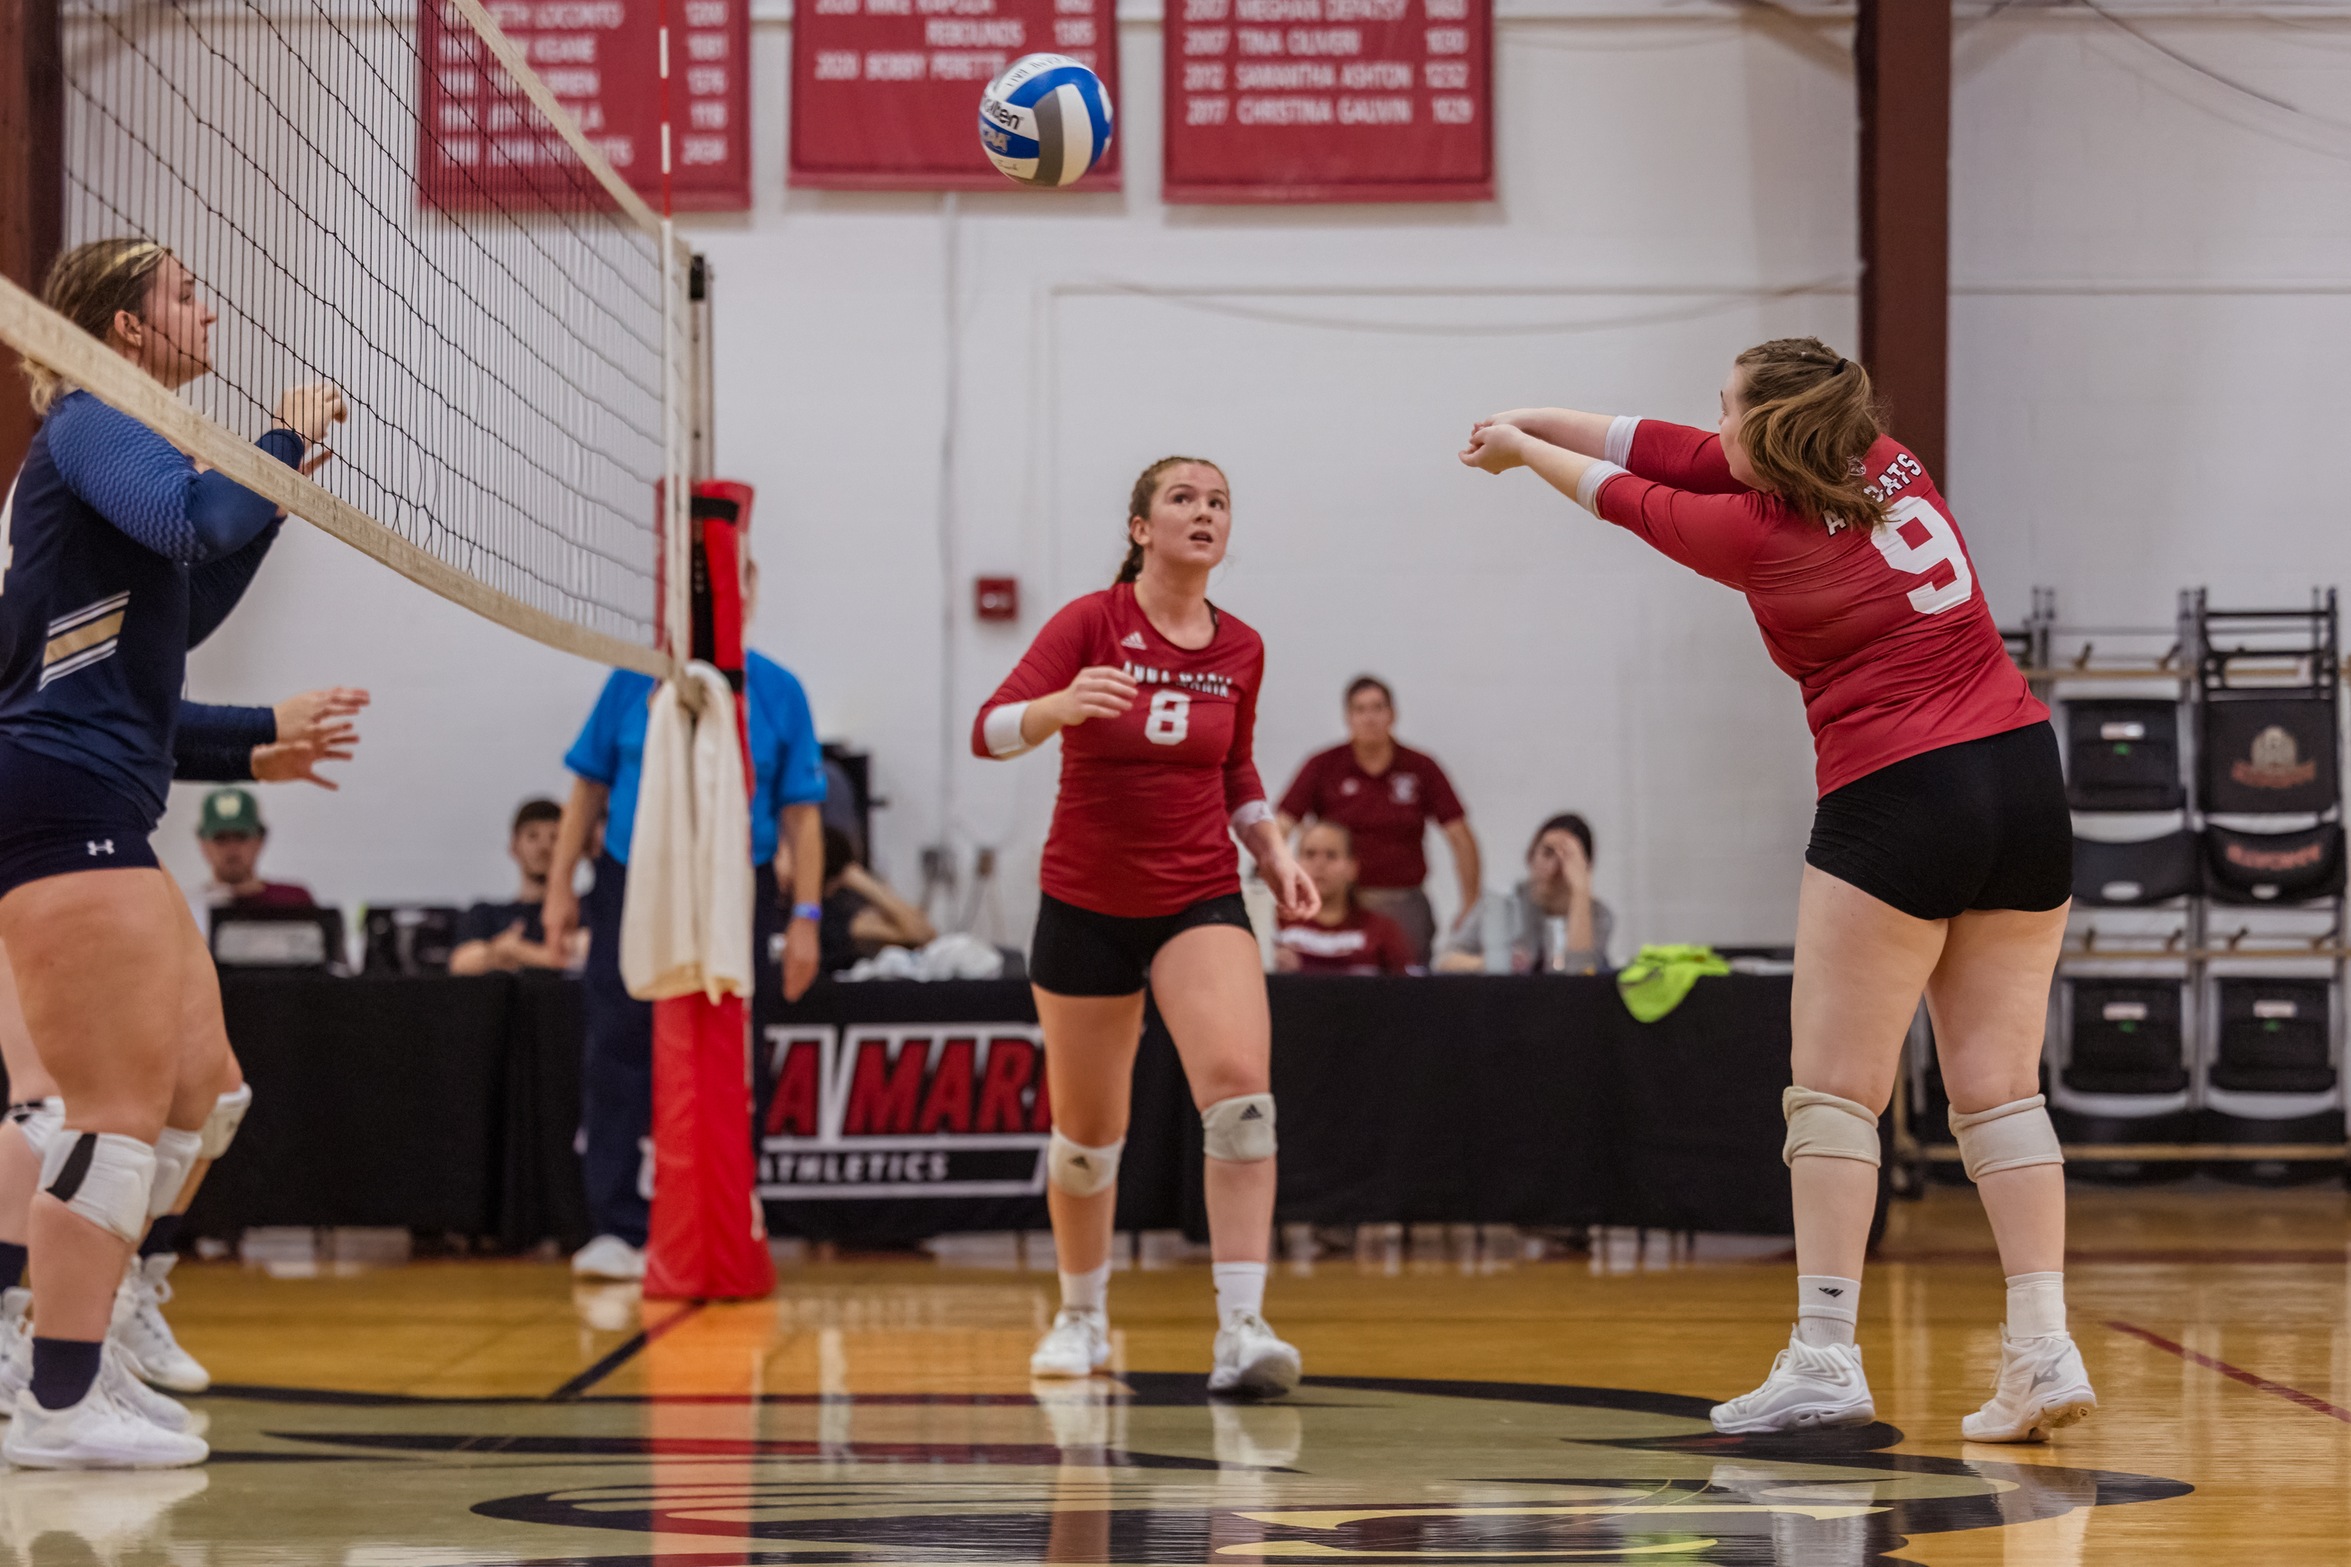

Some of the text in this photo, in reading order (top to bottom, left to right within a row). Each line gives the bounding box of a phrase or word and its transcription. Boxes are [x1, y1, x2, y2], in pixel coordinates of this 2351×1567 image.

[981, 98, 1021, 131] olten
[1870, 495, 1973, 616] 9
[1144, 688, 1192, 747] 8
[839, 1035, 1054, 1136] MAR
[758, 1152, 950, 1183] ATHLETICS
